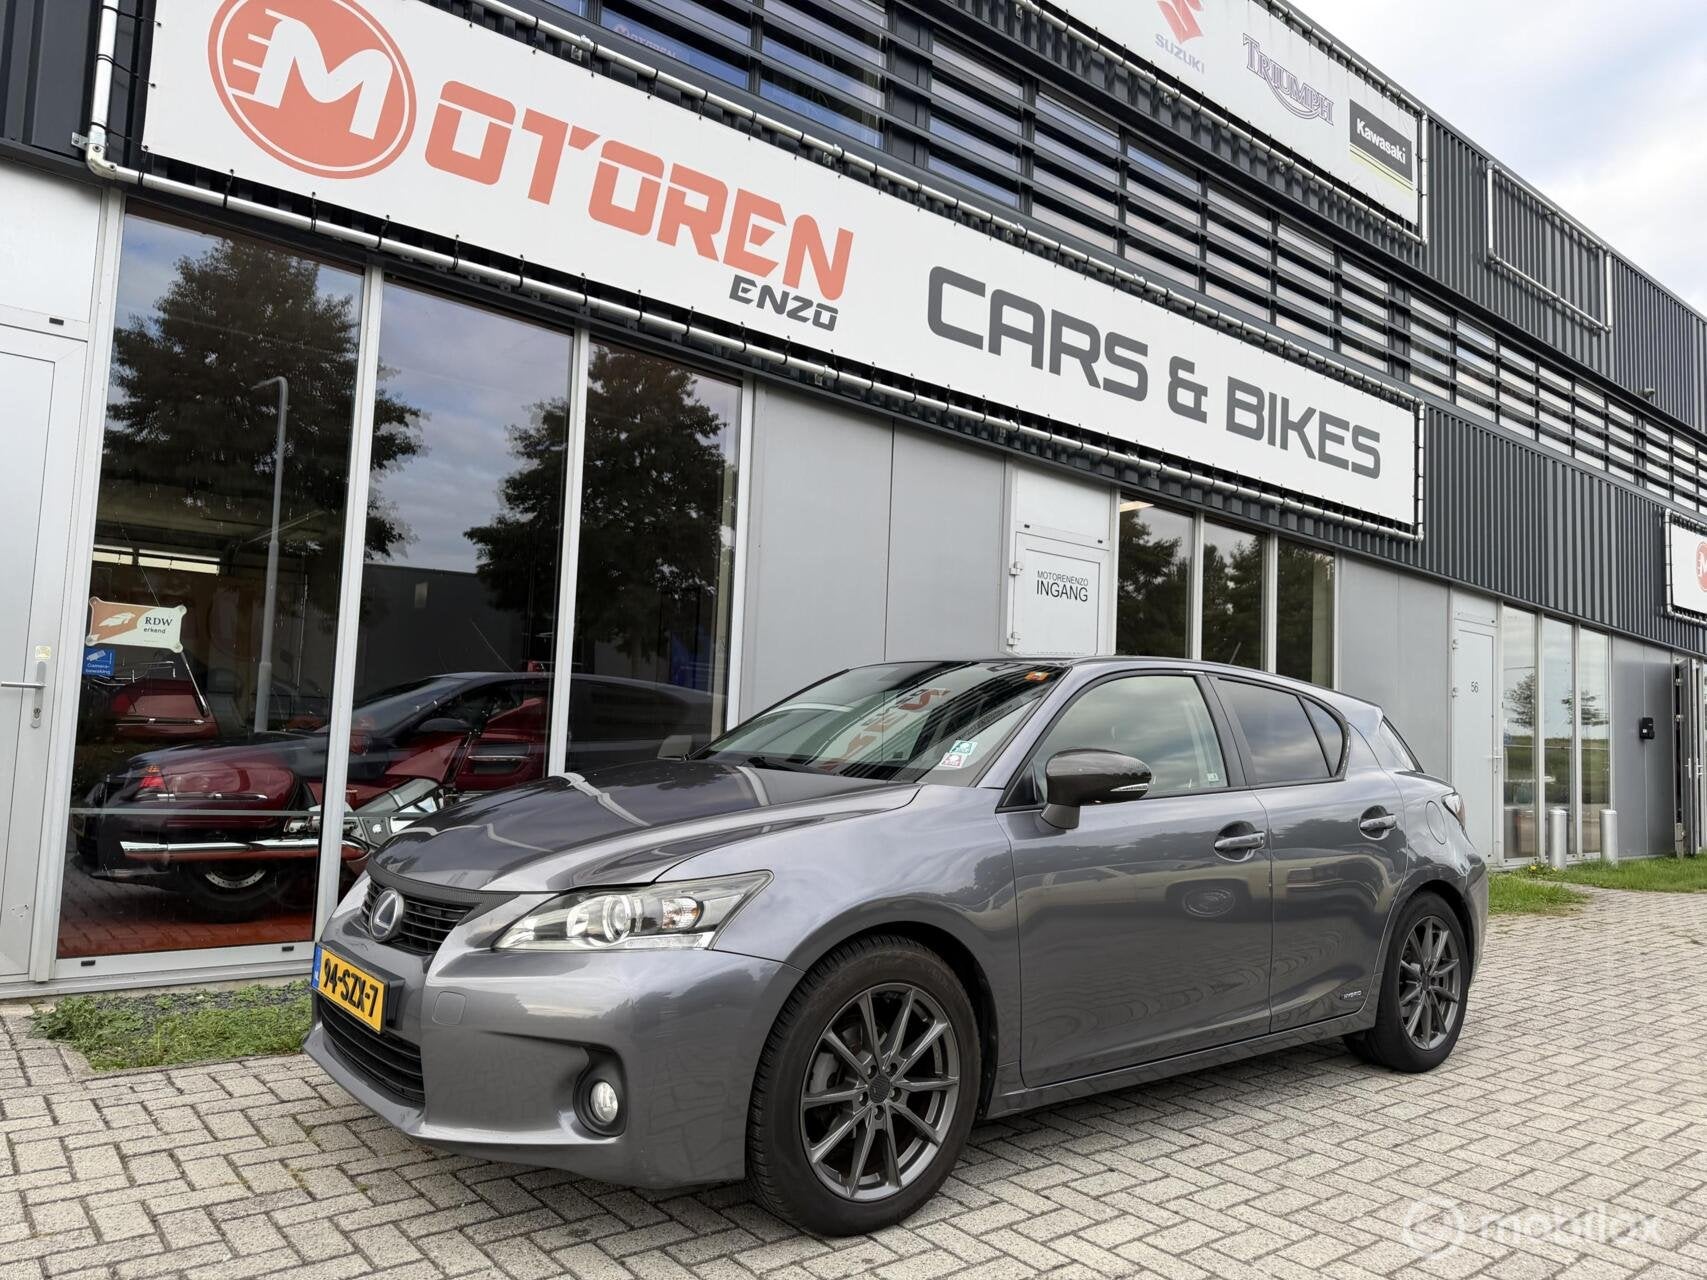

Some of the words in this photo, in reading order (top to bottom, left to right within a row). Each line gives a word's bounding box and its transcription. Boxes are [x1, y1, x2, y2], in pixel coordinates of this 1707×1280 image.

[1155, 33, 1205, 75] SUZUKI
[1242, 33, 1334, 126] TRIUMPH
[222, 6, 854, 301] MOTOREN
[1356, 118, 1406, 164] Kawasaki
[729, 274, 840, 332] ENZO
[927, 265, 1149, 402] CARS
[1167, 355, 1208, 424] &
[1225, 375, 1381, 480] BIKES
[1036, 579, 1088, 602] INGANG
[1037, 570, 1089, 587] MOTORENENZO
[144, 616, 173, 626] RDW
[1471, 680, 1479, 693] 56
[323, 957, 379, 1018] 94-SZX-7
